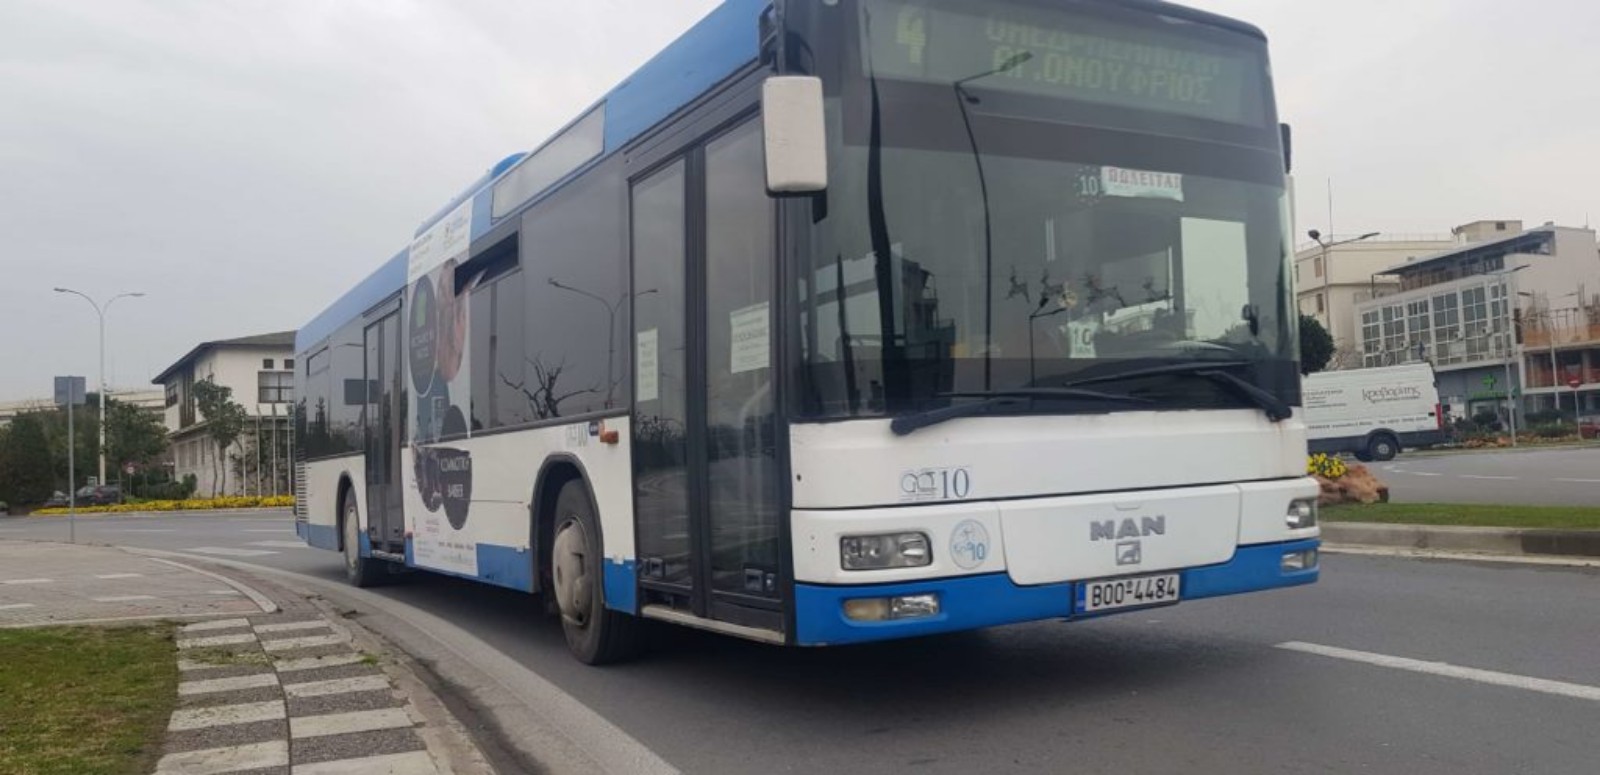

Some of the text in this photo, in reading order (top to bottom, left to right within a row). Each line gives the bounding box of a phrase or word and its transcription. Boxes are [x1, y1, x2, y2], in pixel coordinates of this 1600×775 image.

[896, 5, 926, 64] 4
[1079, 174, 1098, 196] 10
[942, 468, 970, 499] 10
[1090, 515, 1166, 541] MAN
